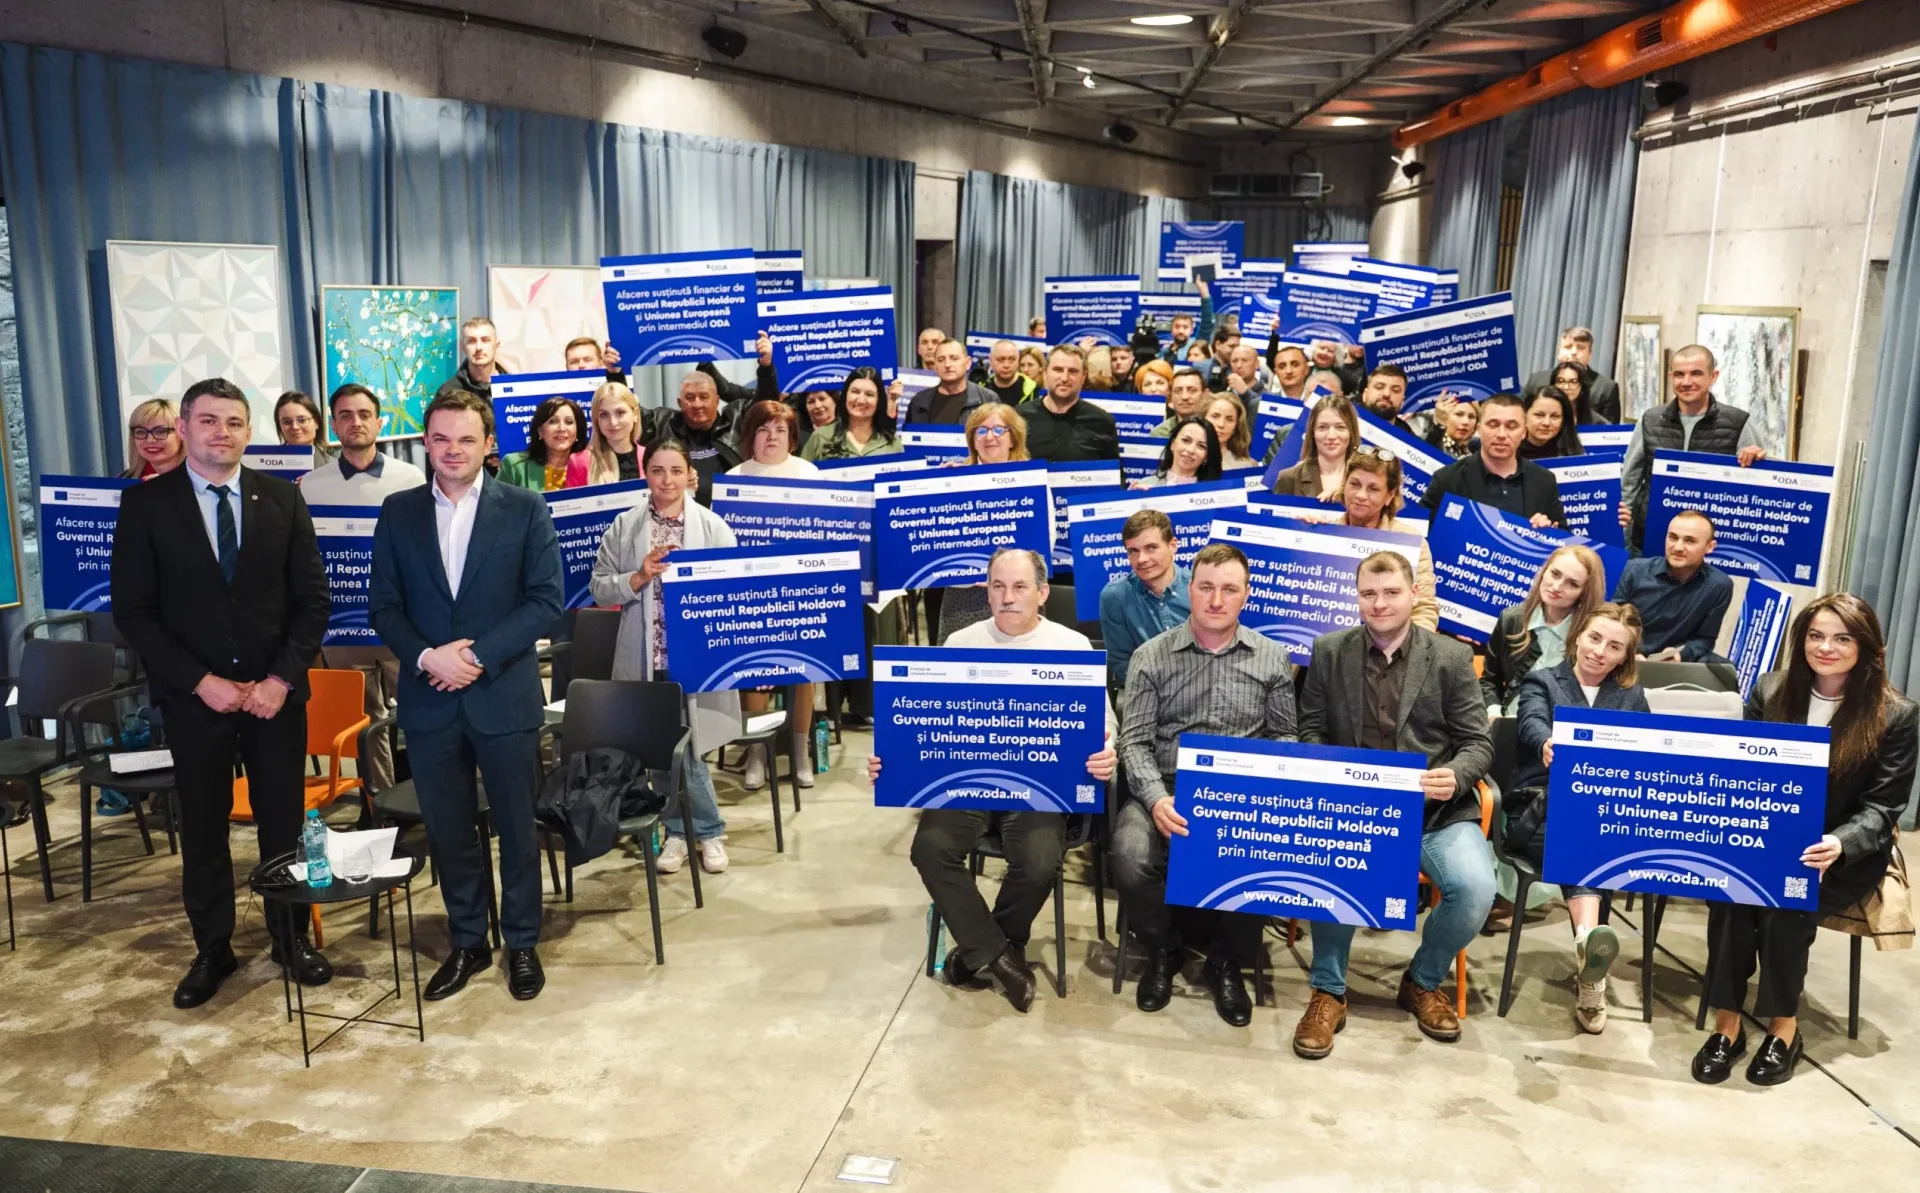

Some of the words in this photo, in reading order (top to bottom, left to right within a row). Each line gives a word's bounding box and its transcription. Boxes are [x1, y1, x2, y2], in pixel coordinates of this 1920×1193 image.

[617, 290, 650, 299] Afacere
[652, 286, 691, 298] susținută
[693, 284, 731, 294] financiar
[733, 283, 745, 292] de
[618, 300, 659, 311] Guvernul
[661, 297, 705, 309] Republicii
[707, 295, 745, 305] Moldova
[645, 311, 681, 321] Uniunea
[683, 307, 731, 319] Europeană
[639, 324, 656, 334] prin
[658, 320, 707, 331] intermediul
[709, 319, 730, 328] ODA
[769, 324, 799, 332] Afacere
[838, 318, 871, 327] financiar
[873, 317, 884, 325] de
[770, 333, 807, 342] Guvernul
[808, 330, 848, 341] Republicii
[850, 328, 884, 337] Moldova
[1377, 346, 1409, 357] Afacere
[1452, 330, 1489, 342] financiar
[1491, 327, 1503, 335] de
[660, 346, 714, 356] www.oda.md
[793, 343, 826, 351] Uniunea
[828, 338, 871, 349] Europeană
[1420, 344, 1463, 359] Republicii
[1465, 338, 1503, 351] Moldova
[788, 354, 804, 363] prin
[806, 350, 850, 361] intermediul
[852, 350, 870, 358] ODA
[1404, 361, 1439, 373] Uniunea
[1441, 349, 1488, 366] Europeană
[1417, 365, 1465, 381] intermediul
[1467, 361, 1488, 371] ODA
[505, 404, 537, 413] Afacere
[1410, 453, 1426, 466] ODA
[1778, 477, 1798, 486] ODA
[1195, 498, 1215, 506] ODA
[1594, 490, 1607, 499] de
[1663, 486, 1701, 498] Afacere
[1703, 493, 1748, 504] susținută
[1752, 495, 1796, 509] financiar
[1799, 501, 1813, 511] de
[889, 507, 926, 516] Afacere
[930, 501, 973, 514] susținută
[976, 498, 1018, 509] financiar
[1021, 496, 1034, 506] de
[1564, 503, 1607, 513] Moldova
[1663, 499, 1708, 511] Guvernul
[1710, 504, 1762, 518] Republicii
[1764, 510, 1810, 524] Moldova
[56, 516, 94, 528] Afacere
[724, 513, 763, 524] Afacere
[766, 516, 811, 527] susținută
[814, 517, 856, 528] financiar
[859, 520, 872, 529] de
[890, 516, 936, 528] Guvernul
[938, 512, 988, 525] Republicii
[991, 510, 1034, 520] Moldova
[1733, 519, 1789, 534] Europeană
[56, 531, 104, 542] Guvernul
[773, 529, 824, 540] Republicii
[909, 530, 916, 541] și
[919, 528, 960, 538] Uniunea
[963, 522, 1017, 535] Europeană
[1497, 521, 1565, 547] www.oda.md
[912, 542, 931, 553] prin
[934, 537, 990, 549] intermediul
[992, 535, 1016, 545] ODA
[1761, 535, 1785, 546] ODA
[76, 546, 83, 557] și
[566, 551, 574, 562] și
[1466, 542, 1489, 557] ODA
[78, 560, 98, 571] prin
[570, 562, 589, 574] prin
[804, 559, 826, 568] ODA
[1269, 562, 1321, 576] susținută
[1457, 554, 1515, 581] Europeană
[1435, 561, 1480, 583] Moldova
[1276, 576, 1337, 593] Republicii
[1445, 579, 1489, 602] financiar
[680, 593, 724, 604] Afacere
[728, 588, 778, 602] susținută
[781, 585, 828, 597] financiar
[832, 583, 846, 594] de
[1250, 587, 1298, 603] Uniunea
[682, 605, 735, 619] Guvernul
[738, 601, 795, 616] Republicii
[798, 599, 846, 611] Moldova
[1263, 603, 1331, 622] intermediul
[1334, 615, 1361, 628] ODA
[704, 622, 713, 635] și
[716, 620, 763, 632] Uniunea
[766, 613, 827, 628] Europeană
[708, 636, 730, 649] prin
[734, 630, 797, 645] intermediul
[800, 629, 826, 640] ODA
[734, 663, 805, 678] www.oda.md
[1039, 671, 1065, 680] ODA
[892, 696, 942, 709] Afacere
[946, 698, 1005, 712] susținută
[1009, 699, 1065, 712] financiar
[1069, 701, 1086, 713] de
[893, 714, 953, 726] Guvernul
[958, 715, 1024, 729] Republicii
[1028, 717, 1085, 729] Moldova
[918, 731, 926, 744] și
[931, 731, 985, 744] Uniunea
[989, 733, 1061, 747] Europeană
[920, 748, 945, 761] prin
[950, 749, 1024, 761] intermediul
[1028, 751, 1058, 762] ODA
[1747, 745, 1778, 757] ODA
[1352, 770, 1380, 782] ODA
[1572, 762, 1630, 779] Afacere
[1635, 770, 1704, 786] susținută
[1709, 774, 1777, 792] financiar
[1782, 781, 1803, 795] de
[947, 789, 1030, 799] www.oda.md
[1572, 781, 1642, 799] Guvernul
[1647, 788, 1726, 807] Republicii
[1731, 796, 1800, 814] Moldova
[1194, 787, 1246, 803] Afacere
[1251, 795, 1313, 810] susținută
[1318, 798, 1379, 816] financiar
[1383, 805, 1402, 819] de
[1194, 805, 1257, 822] Guvernul
[1262, 812, 1333, 830] Republicii
[1337, 820, 1399, 837] Moldova
[1598, 802, 1609, 816] și
[1614, 804, 1678, 821] Uniunea
[1683, 810, 1769, 830] Europeană
[1217, 826, 1227, 839] și
[1232, 827, 1289, 844] Uniunea
[1294, 833, 1371, 852] Europeană
[1600, 822, 1630, 835] prin
[1635, 824, 1723, 844] intermediul
[1728, 834, 1765, 848] ODA
[1219, 845, 1245, 857] prin
[1250, 847, 1330, 866] intermediul
[1334, 856, 1368, 870] ODA
[1629, 871, 1728, 888] www.oda.md
[1245, 892, 1334, 909] www.oda.md
